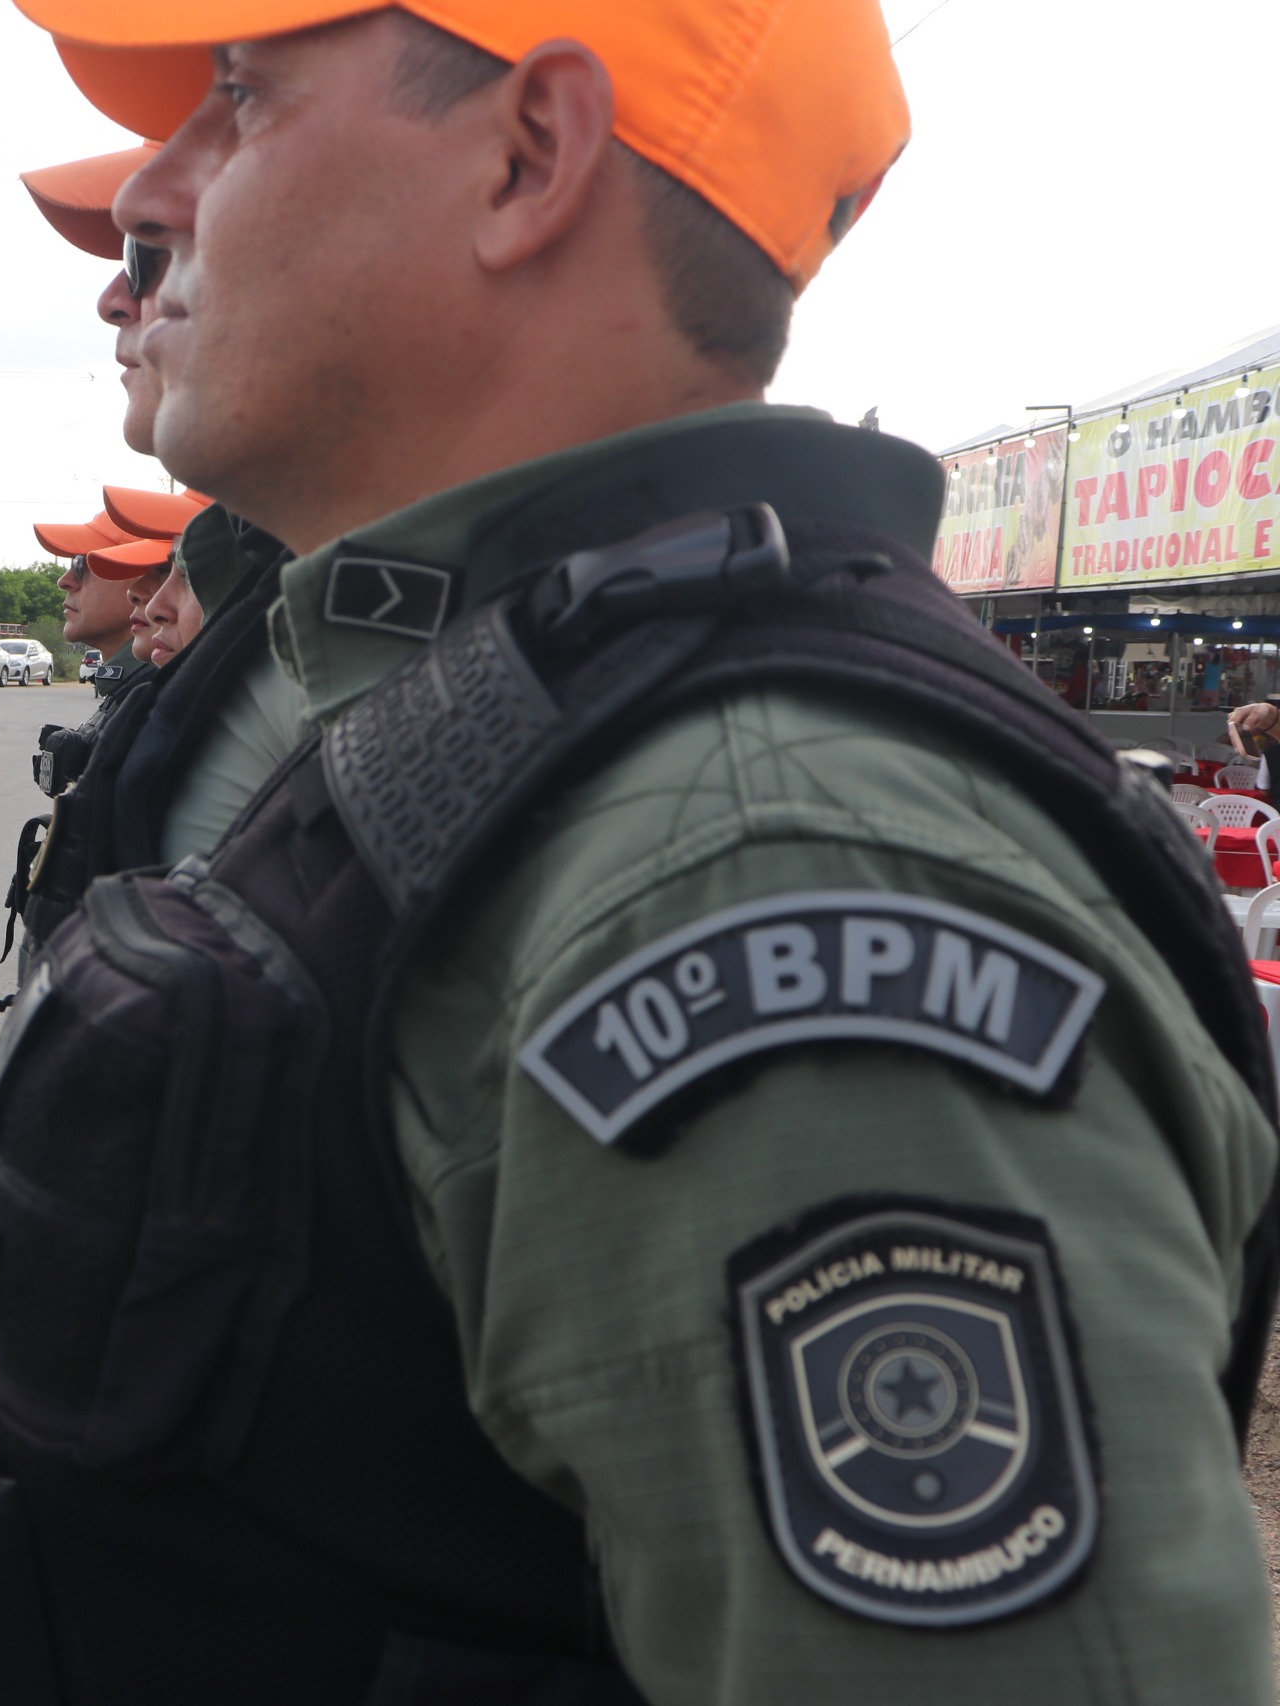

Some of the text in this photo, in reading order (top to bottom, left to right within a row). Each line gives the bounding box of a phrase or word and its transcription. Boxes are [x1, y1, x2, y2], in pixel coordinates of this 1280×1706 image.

[1146, 386, 1280, 451] HAMB
[1074, 438, 1280, 527] TAPIOC
[1072, 518, 1274, 577] TRADICIONAL E
[593, 916, 1021, 1081] 10º BPM
[890, 1246, 1026, 1294] MILITAR
[813, 1504, 1067, 1593] PERNAMBUCO
